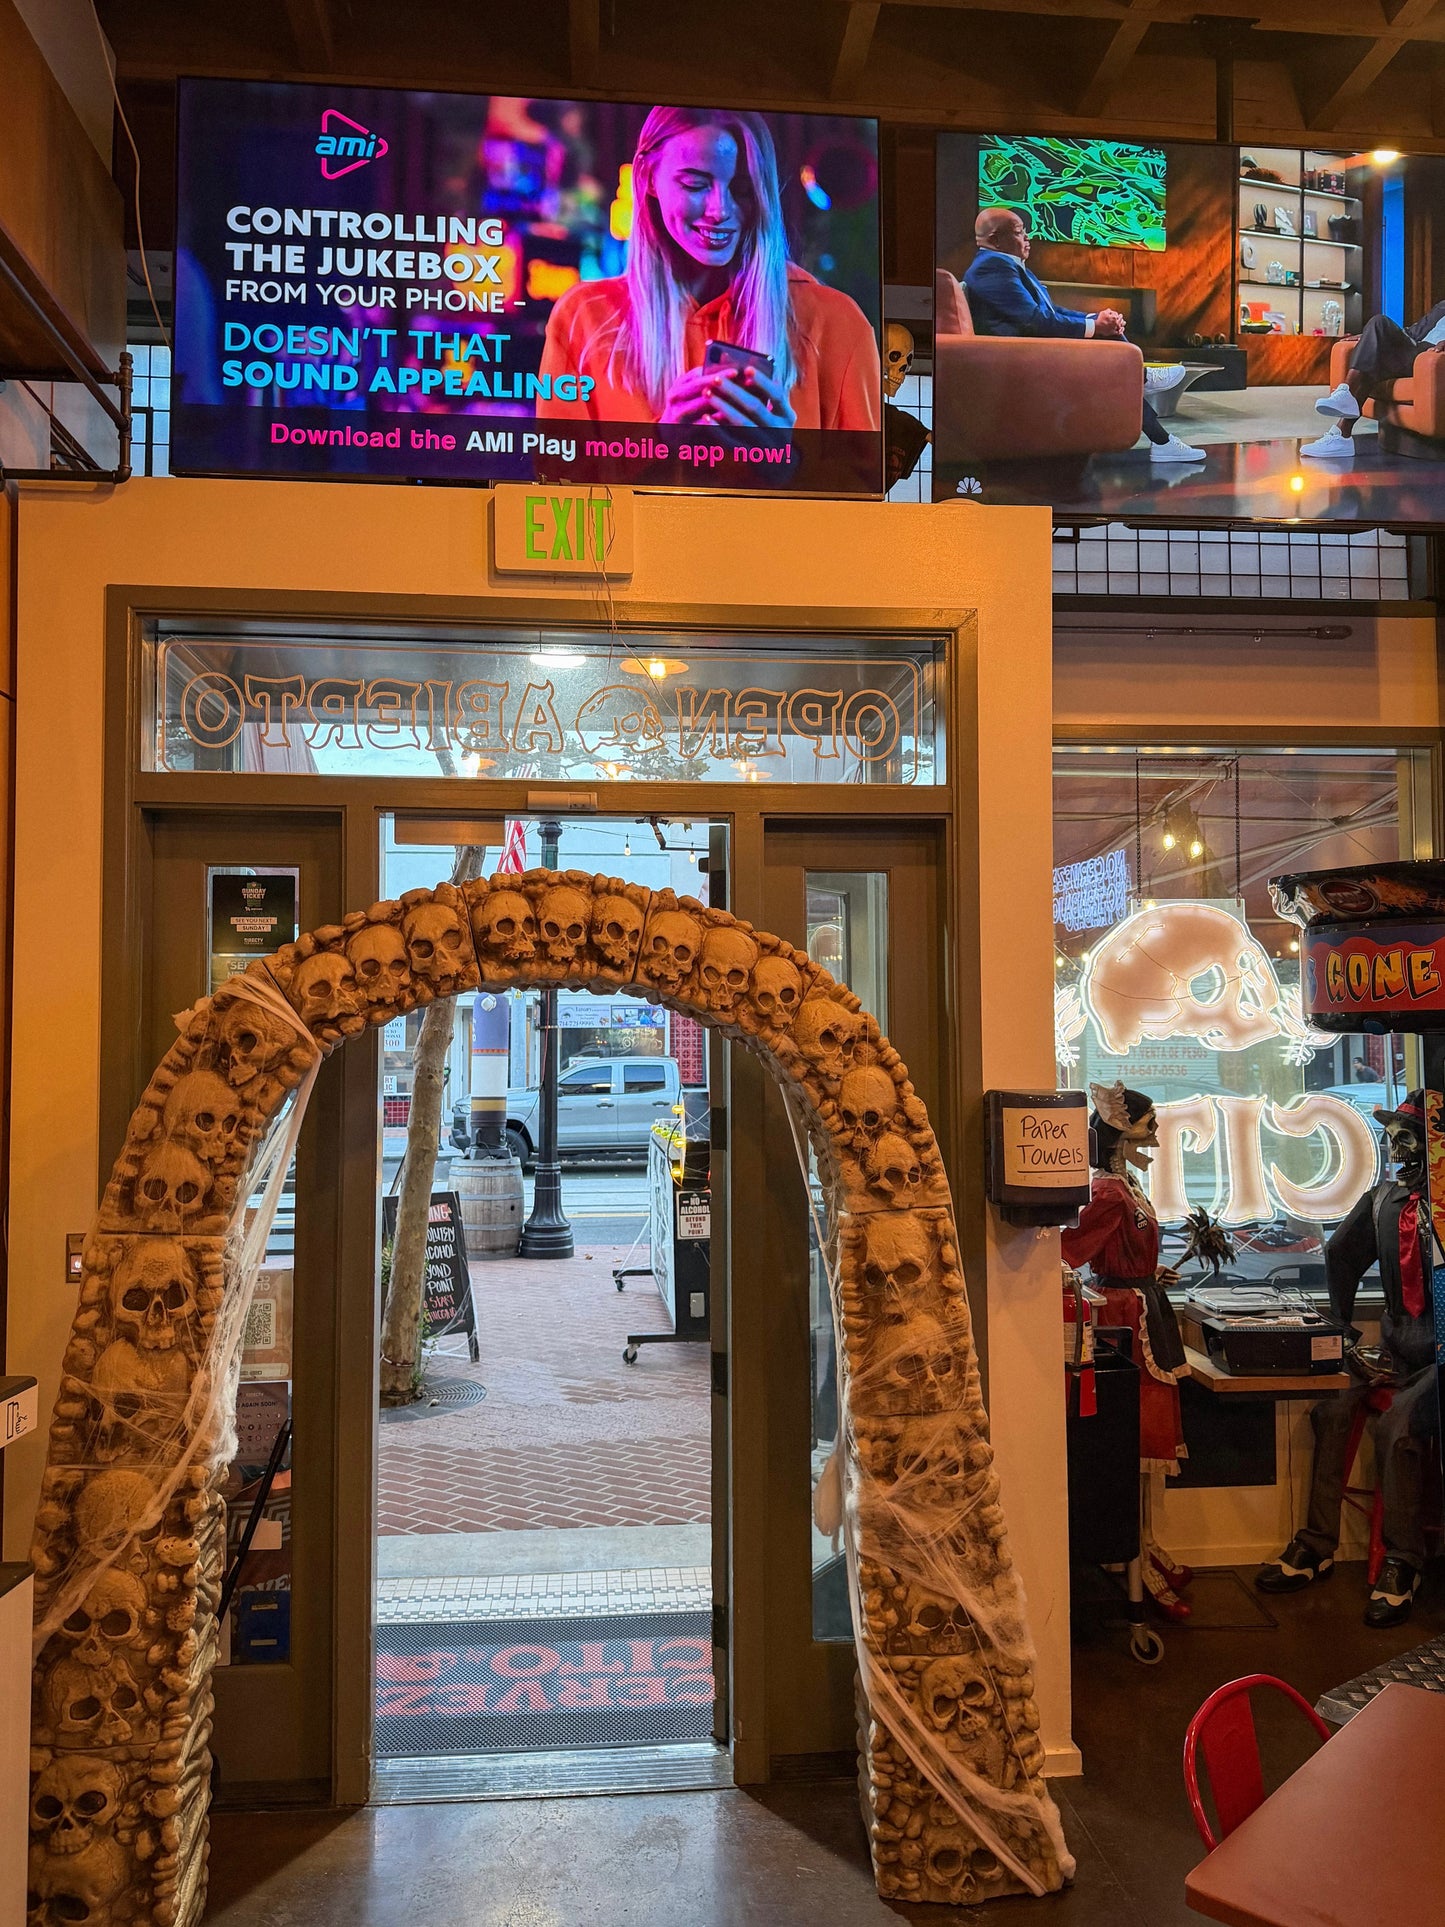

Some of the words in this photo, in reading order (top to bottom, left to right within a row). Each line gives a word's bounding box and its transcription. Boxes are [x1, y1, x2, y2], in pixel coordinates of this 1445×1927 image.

[315, 133, 377, 158] ami
[225, 205, 504, 246] CONTROLLING
[224, 242, 306, 274] THE
[317, 248, 502, 284] JUKEBOX
[225, 280, 307, 305] FROM
[316, 283, 397, 309] YOUR
[406, 287, 505, 314] PHONE
[224, 322, 398, 359] DOESN'T
[408, 329, 511, 363] THAT
[222, 361, 359, 391] SOUND
[368, 366, 596, 402] APPEALING?
[270, 422, 401, 450] Download
[410, 430, 457, 451] the
[465, 431, 514, 454] AMI
[522, 433, 577, 462] Play
[585, 438, 669, 460] mobile
[678, 444, 725, 468] app
[733, 443, 793, 464] now!
[525, 495, 612, 562] EXIT
[1325, 949, 1441, 1004] GONE
[1016, 1144, 1084, 1166] Towels
[680, 1205, 711, 1215] ALCOHOL
[427, 1226, 456, 1243] OLUTELY
[426, 1262, 452, 1281] YOND
[427, 1277, 456, 1295] POINT
[490, 1636, 714, 1678] CITO
[376, 1673, 716, 1718] CERVEZ
